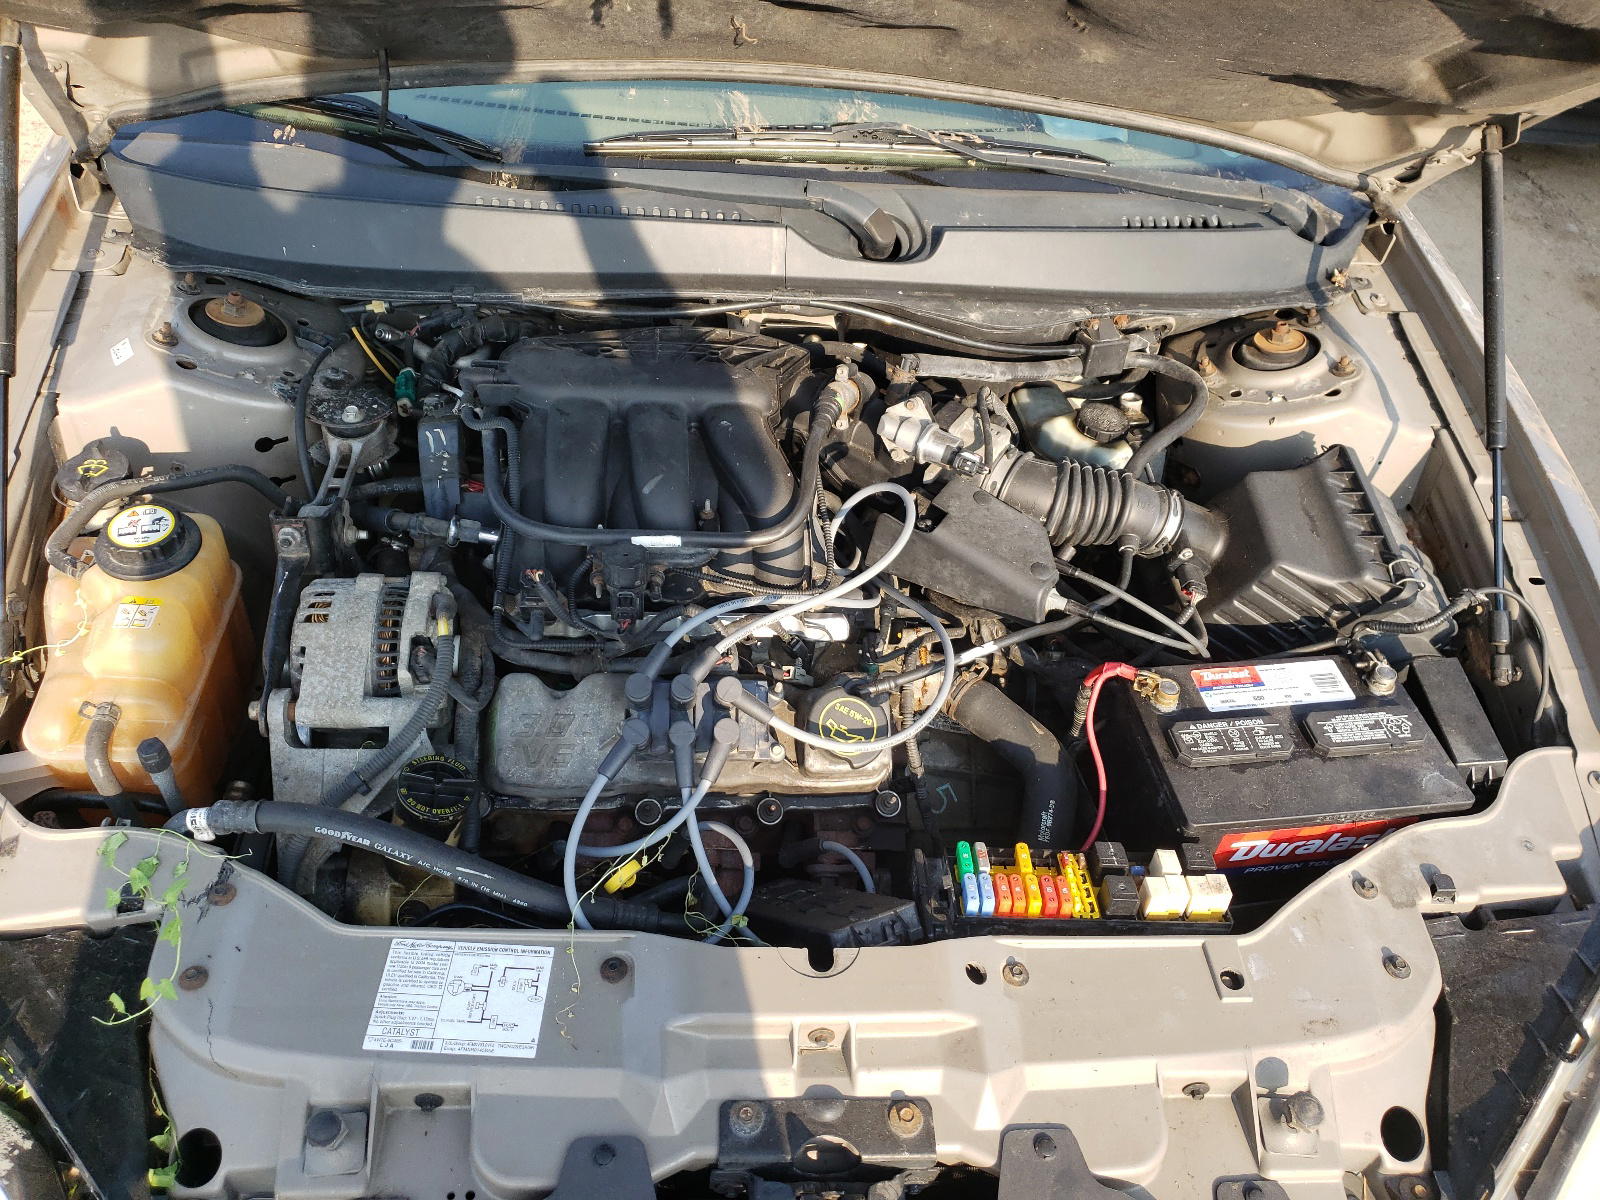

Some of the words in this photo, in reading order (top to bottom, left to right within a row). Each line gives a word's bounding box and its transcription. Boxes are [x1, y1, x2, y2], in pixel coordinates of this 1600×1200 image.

[834, 702, 850, 715] SAE
[1196, 722, 1228, 730] DANGER
[1234, 718, 1264, 726] POISON
[447, 758, 466, 771] FLUID
[416, 804, 430, 812] NOT
[314, 826, 371, 846] GOODYEAR
[374, 842, 414, 861] GALAXY
[417, 860, 431, 868] A/C
[1244, 863, 1304, 874] PROVEN
[382, 1027, 420, 1036] CATALYST
